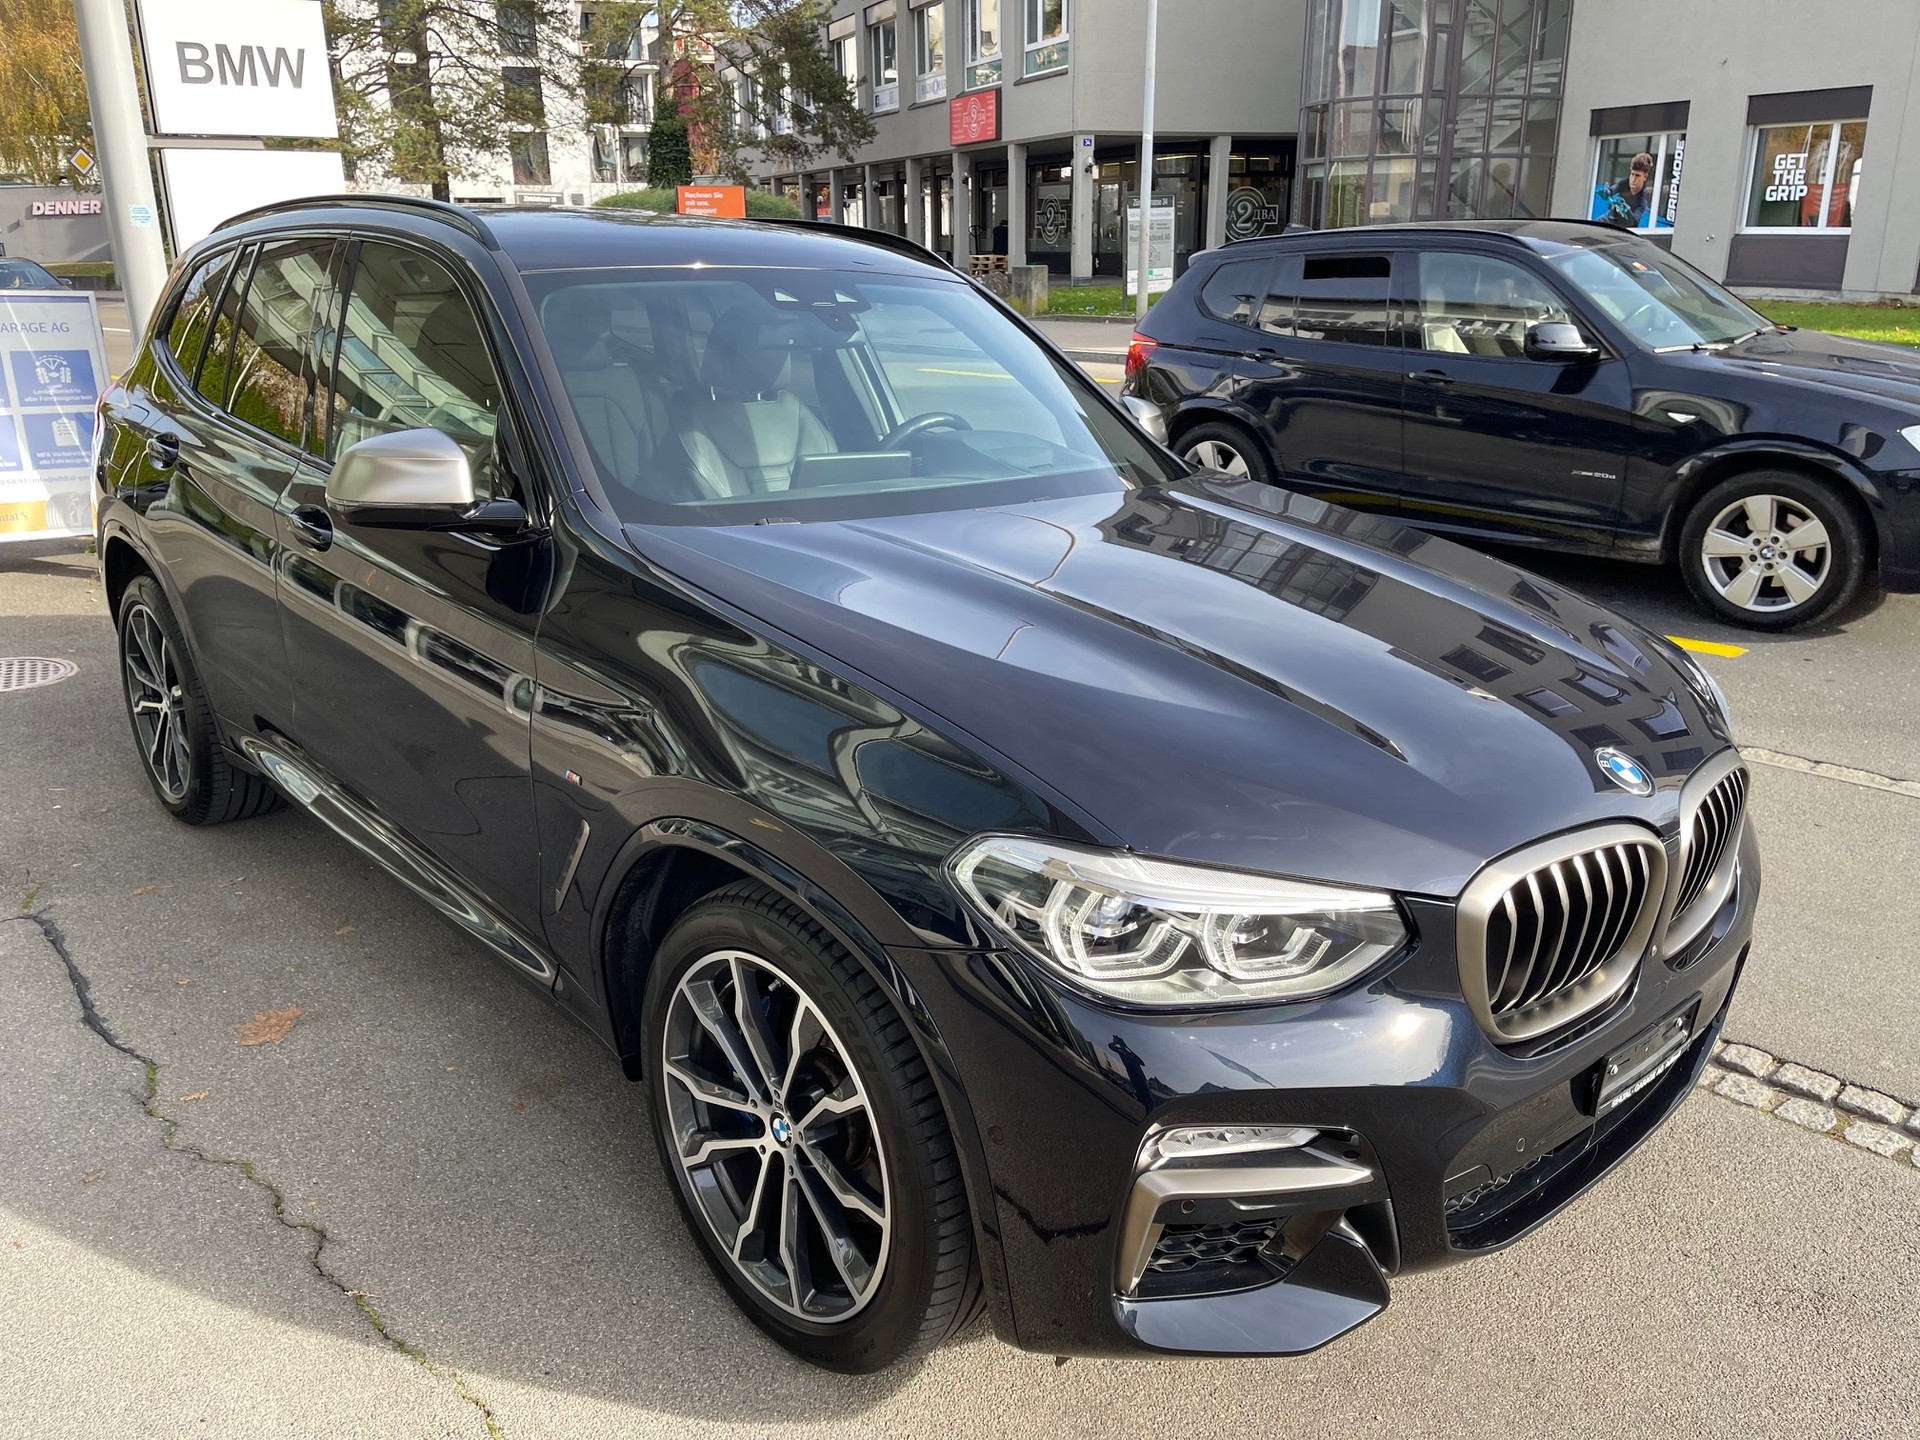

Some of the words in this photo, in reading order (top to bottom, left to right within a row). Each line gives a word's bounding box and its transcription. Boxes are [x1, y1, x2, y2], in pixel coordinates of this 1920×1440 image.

[176, 41, 305, 89] BMW
[1774, 152, 1808, 169] GET
[1666, 139, 1685, 222] GRIPMODE
[1772, 169, 1806, 185] THE
[684, 191, 713, 199] Rechnen
[713, 191, 724, 199] Sie
[32, 199, 102, 216] DENNER
[1236, 201, 1253, 228] 2
[1046, 207, 1055, 229] 2
[51, 321, 70, 333] AG
